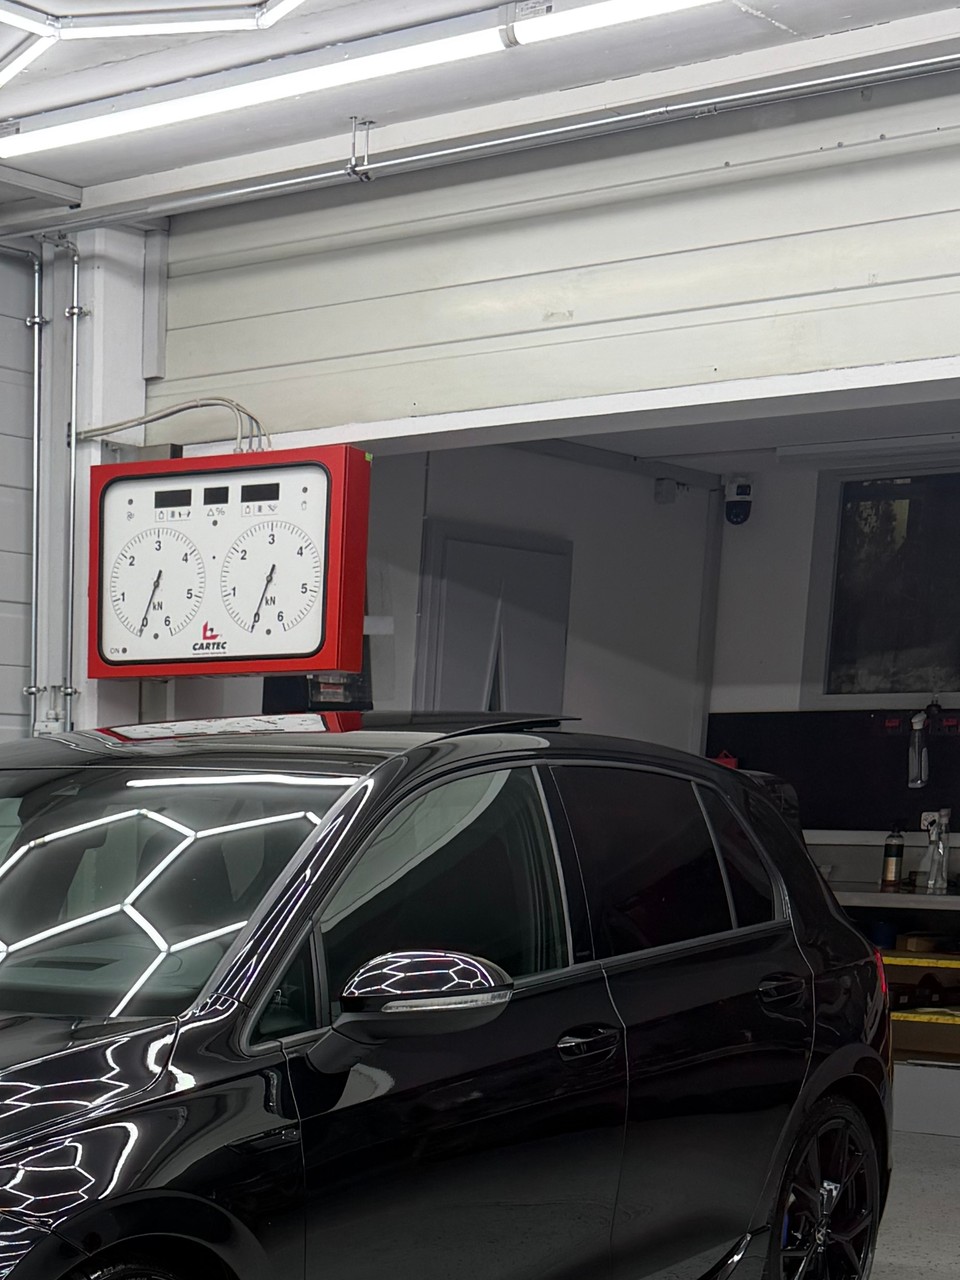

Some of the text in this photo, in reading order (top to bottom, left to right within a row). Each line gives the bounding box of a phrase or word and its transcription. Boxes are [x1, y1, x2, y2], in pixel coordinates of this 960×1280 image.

[268, 533, 275, 545] 3
[155, 540, 161, 551] 3
[240, 549, 247, 560] 2
[297, 546, 303, 557] 4
[128, 556, 135, 566] 2
[182, 553, 188, 563] 4
[186, 589, 193, 599] 5
[232, 586, 236, 597] 1
[301, 583, 308, 594] 5
[121, 592, 125, 601] 1
[265, 596, 276, 606] kN
[152, 601, 163, 611] kN
[164, 616, 171, 626] 6
[253, 612, 260, 623] 0
[277, 611, 284, 622] 6
[142, 617, 148, 628] 0
[192, 641, 227, 651] CARTEC
